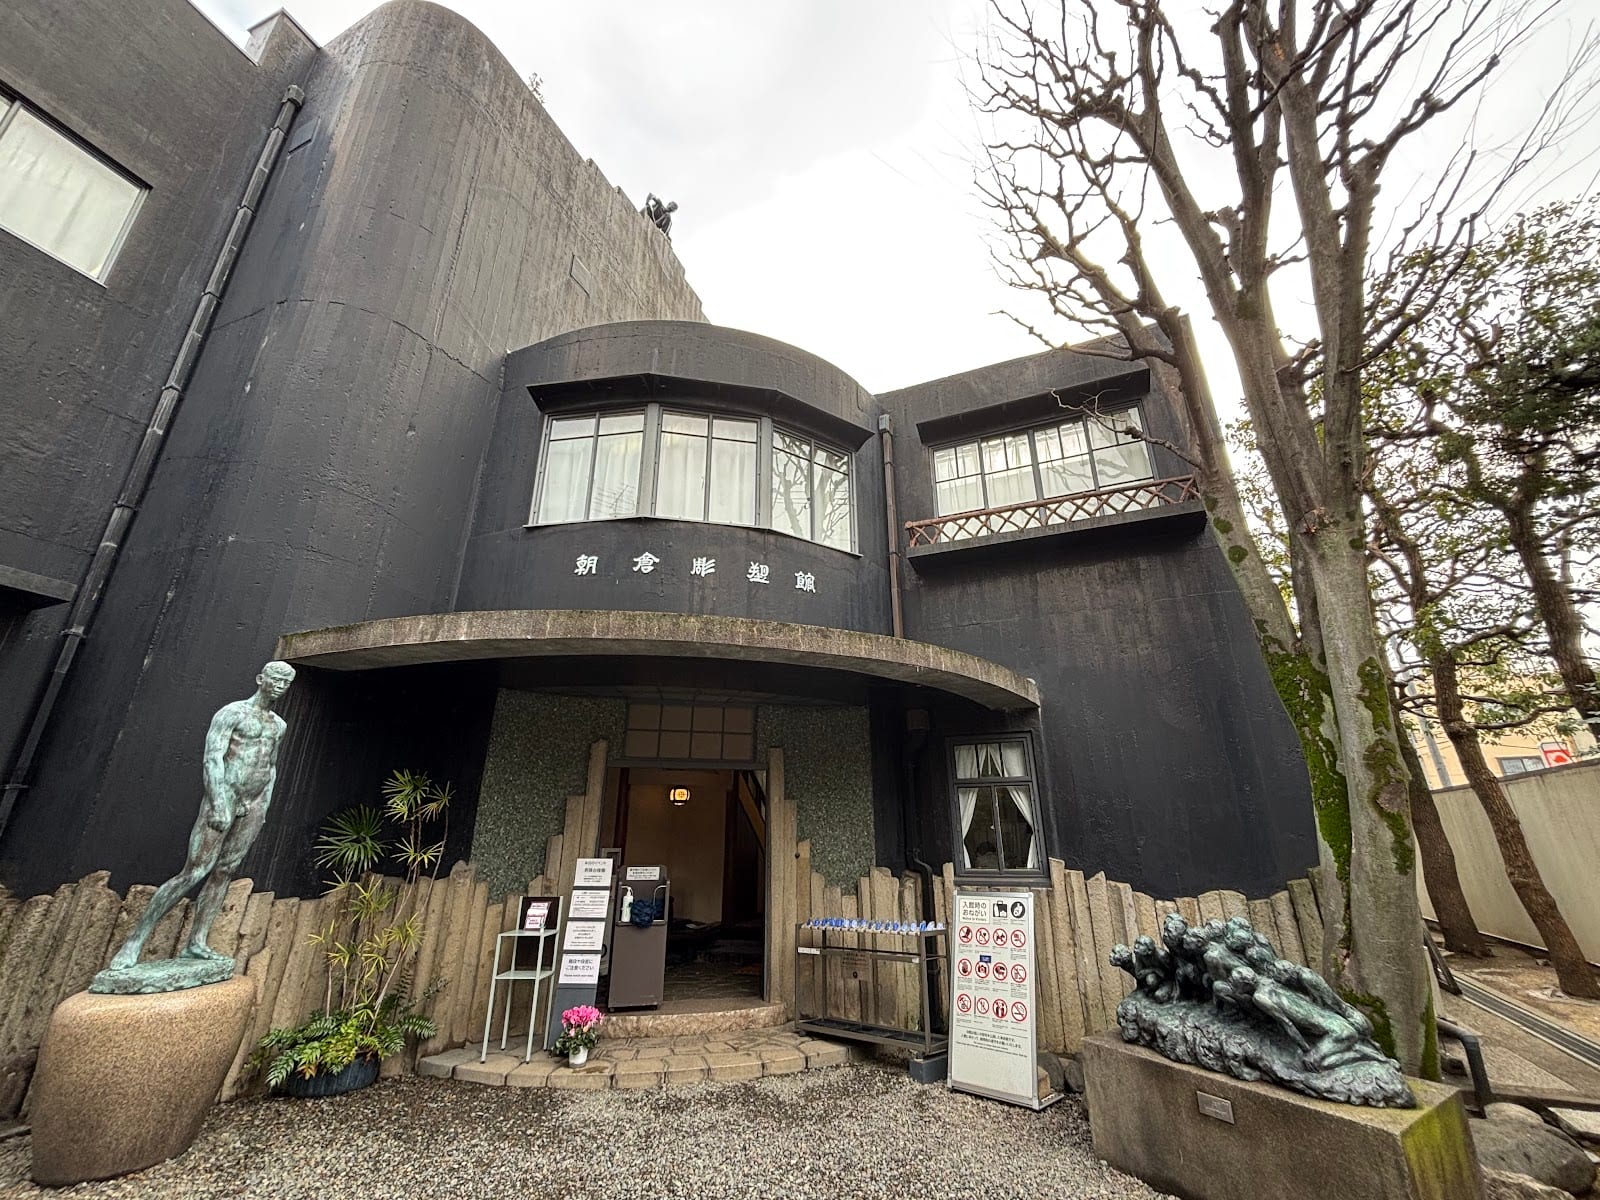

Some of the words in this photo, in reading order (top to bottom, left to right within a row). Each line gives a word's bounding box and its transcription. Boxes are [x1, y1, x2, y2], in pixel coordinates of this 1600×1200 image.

[574, 551, 816, 594] 朝倉彫塑館
[962, 901, 987, 910] 入館時の
[962, 909, 987, 917] おねがい
